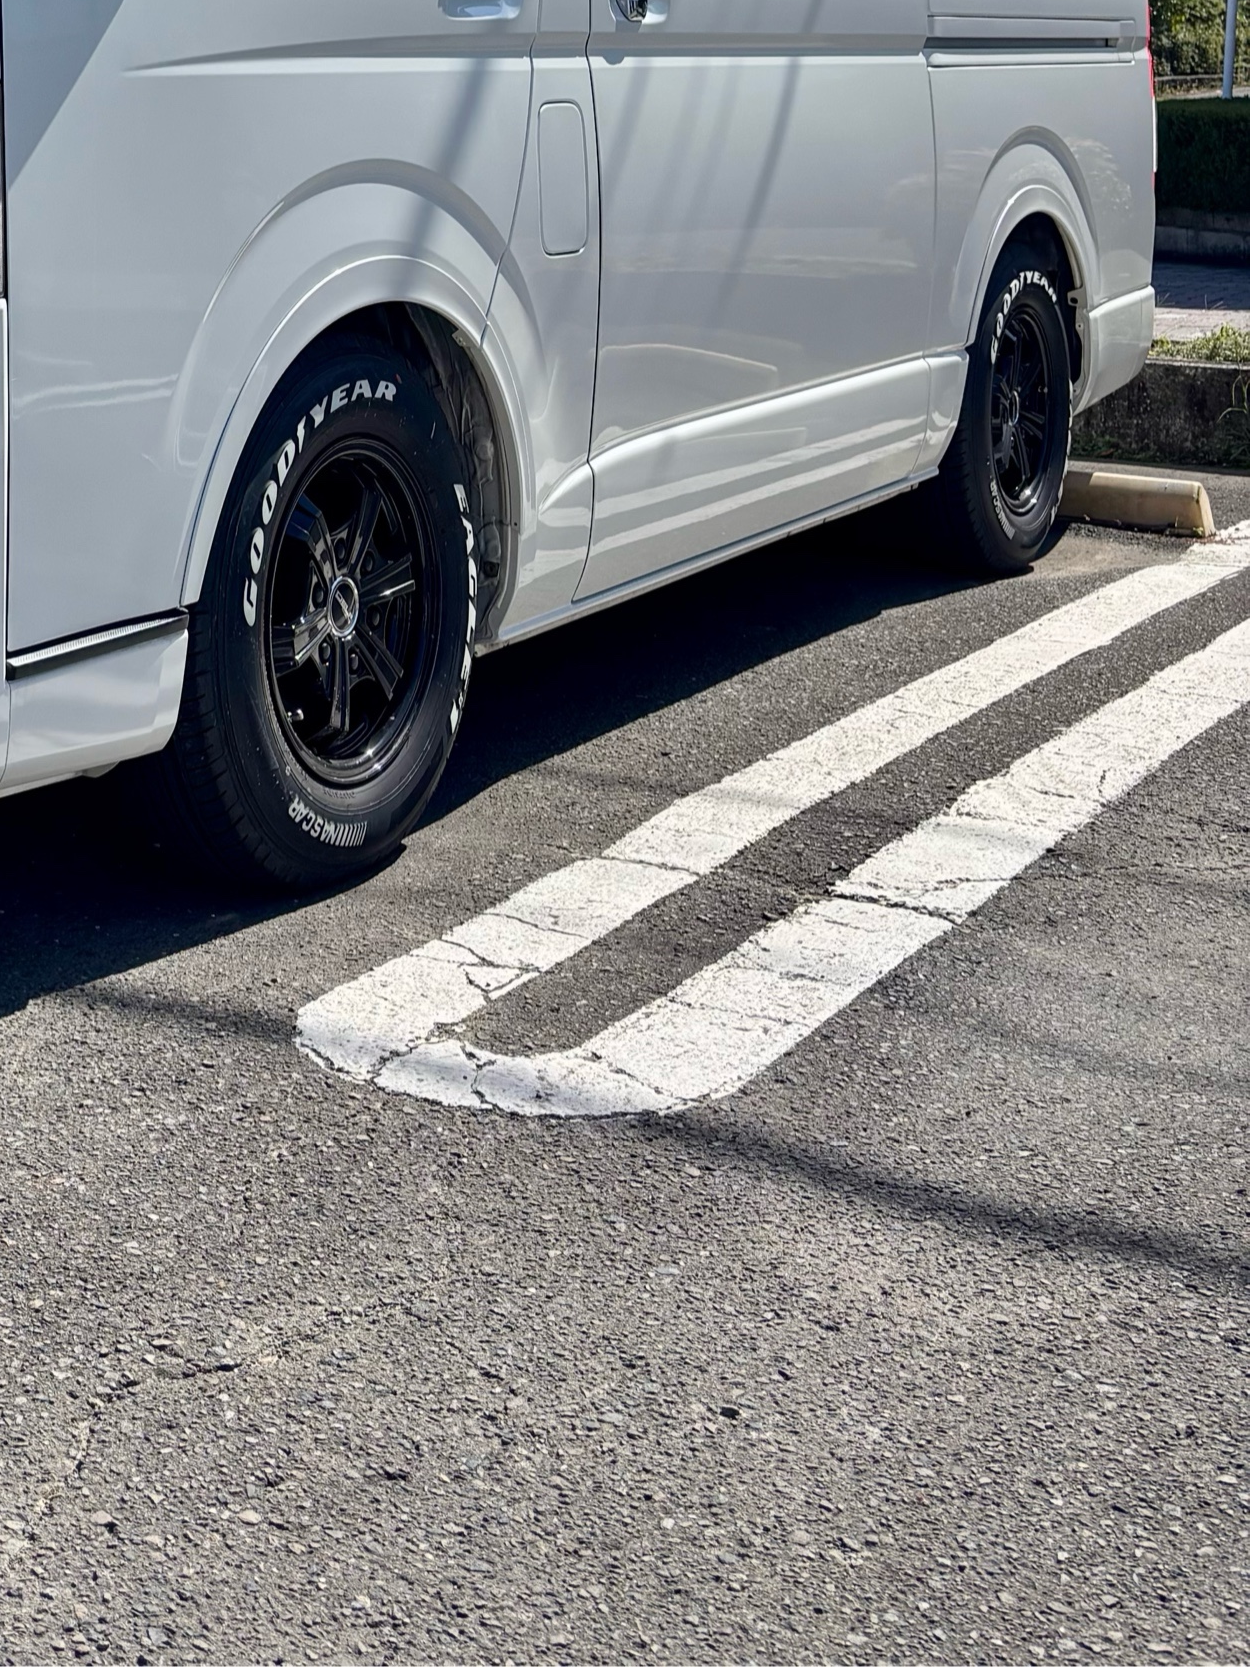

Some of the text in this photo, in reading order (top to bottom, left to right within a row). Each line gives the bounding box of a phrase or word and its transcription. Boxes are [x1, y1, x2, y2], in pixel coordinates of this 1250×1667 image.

[243, 379, 398, 627] GOODYEAR
[453, 483, 478, 690] EAGLE
[288, 793, 340, 846] NASCAR
